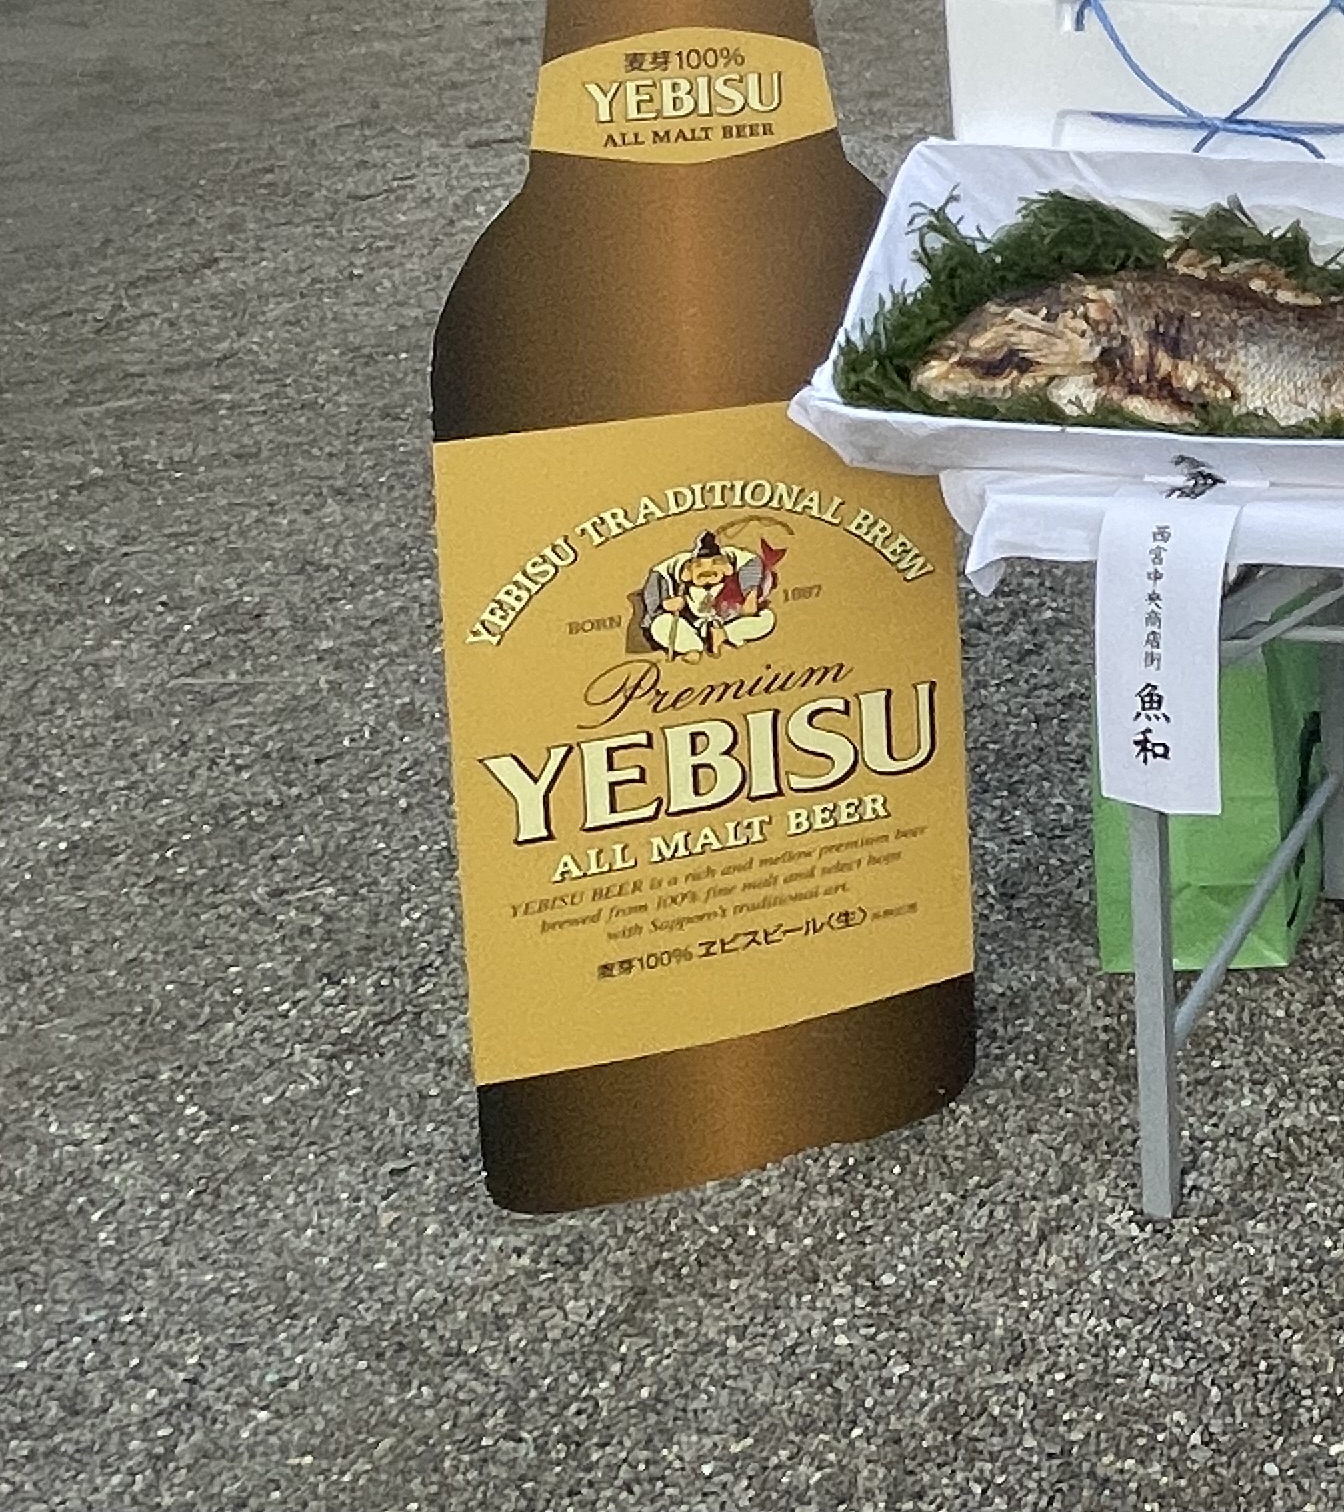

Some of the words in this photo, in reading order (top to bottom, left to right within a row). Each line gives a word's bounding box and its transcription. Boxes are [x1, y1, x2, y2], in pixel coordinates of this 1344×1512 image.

[623, 46, 746, 74] 麦芽100%
[584, 70, 784, 124] YEBISU
[603, 127, 646, 148] ALL
[651, 125, 714, 145] MALT
[721, 121, 776, 140] BEER
[465, 534, 579, 646] YEBISU
[574, 479, 845, 548] TRADITIONAL
[843, 508, 935, 583] BREW
[567, 615, 622, 635] BORN
[576, 657, 855, 730] Premium
[1132, 681, 1172, 766] 魚和
[480, 680, 938, 846] YEBISU
[551, 842, 637, 885] ALL
[650, 814, 773, 864] MALT
[786, 792, 892, 837] BEER
[511, 890, 585, 918] YEBISU
[590, 878, 644, 903] BEER
[721, 856, 754, 876] and
[609, 902, 649, 923] from
